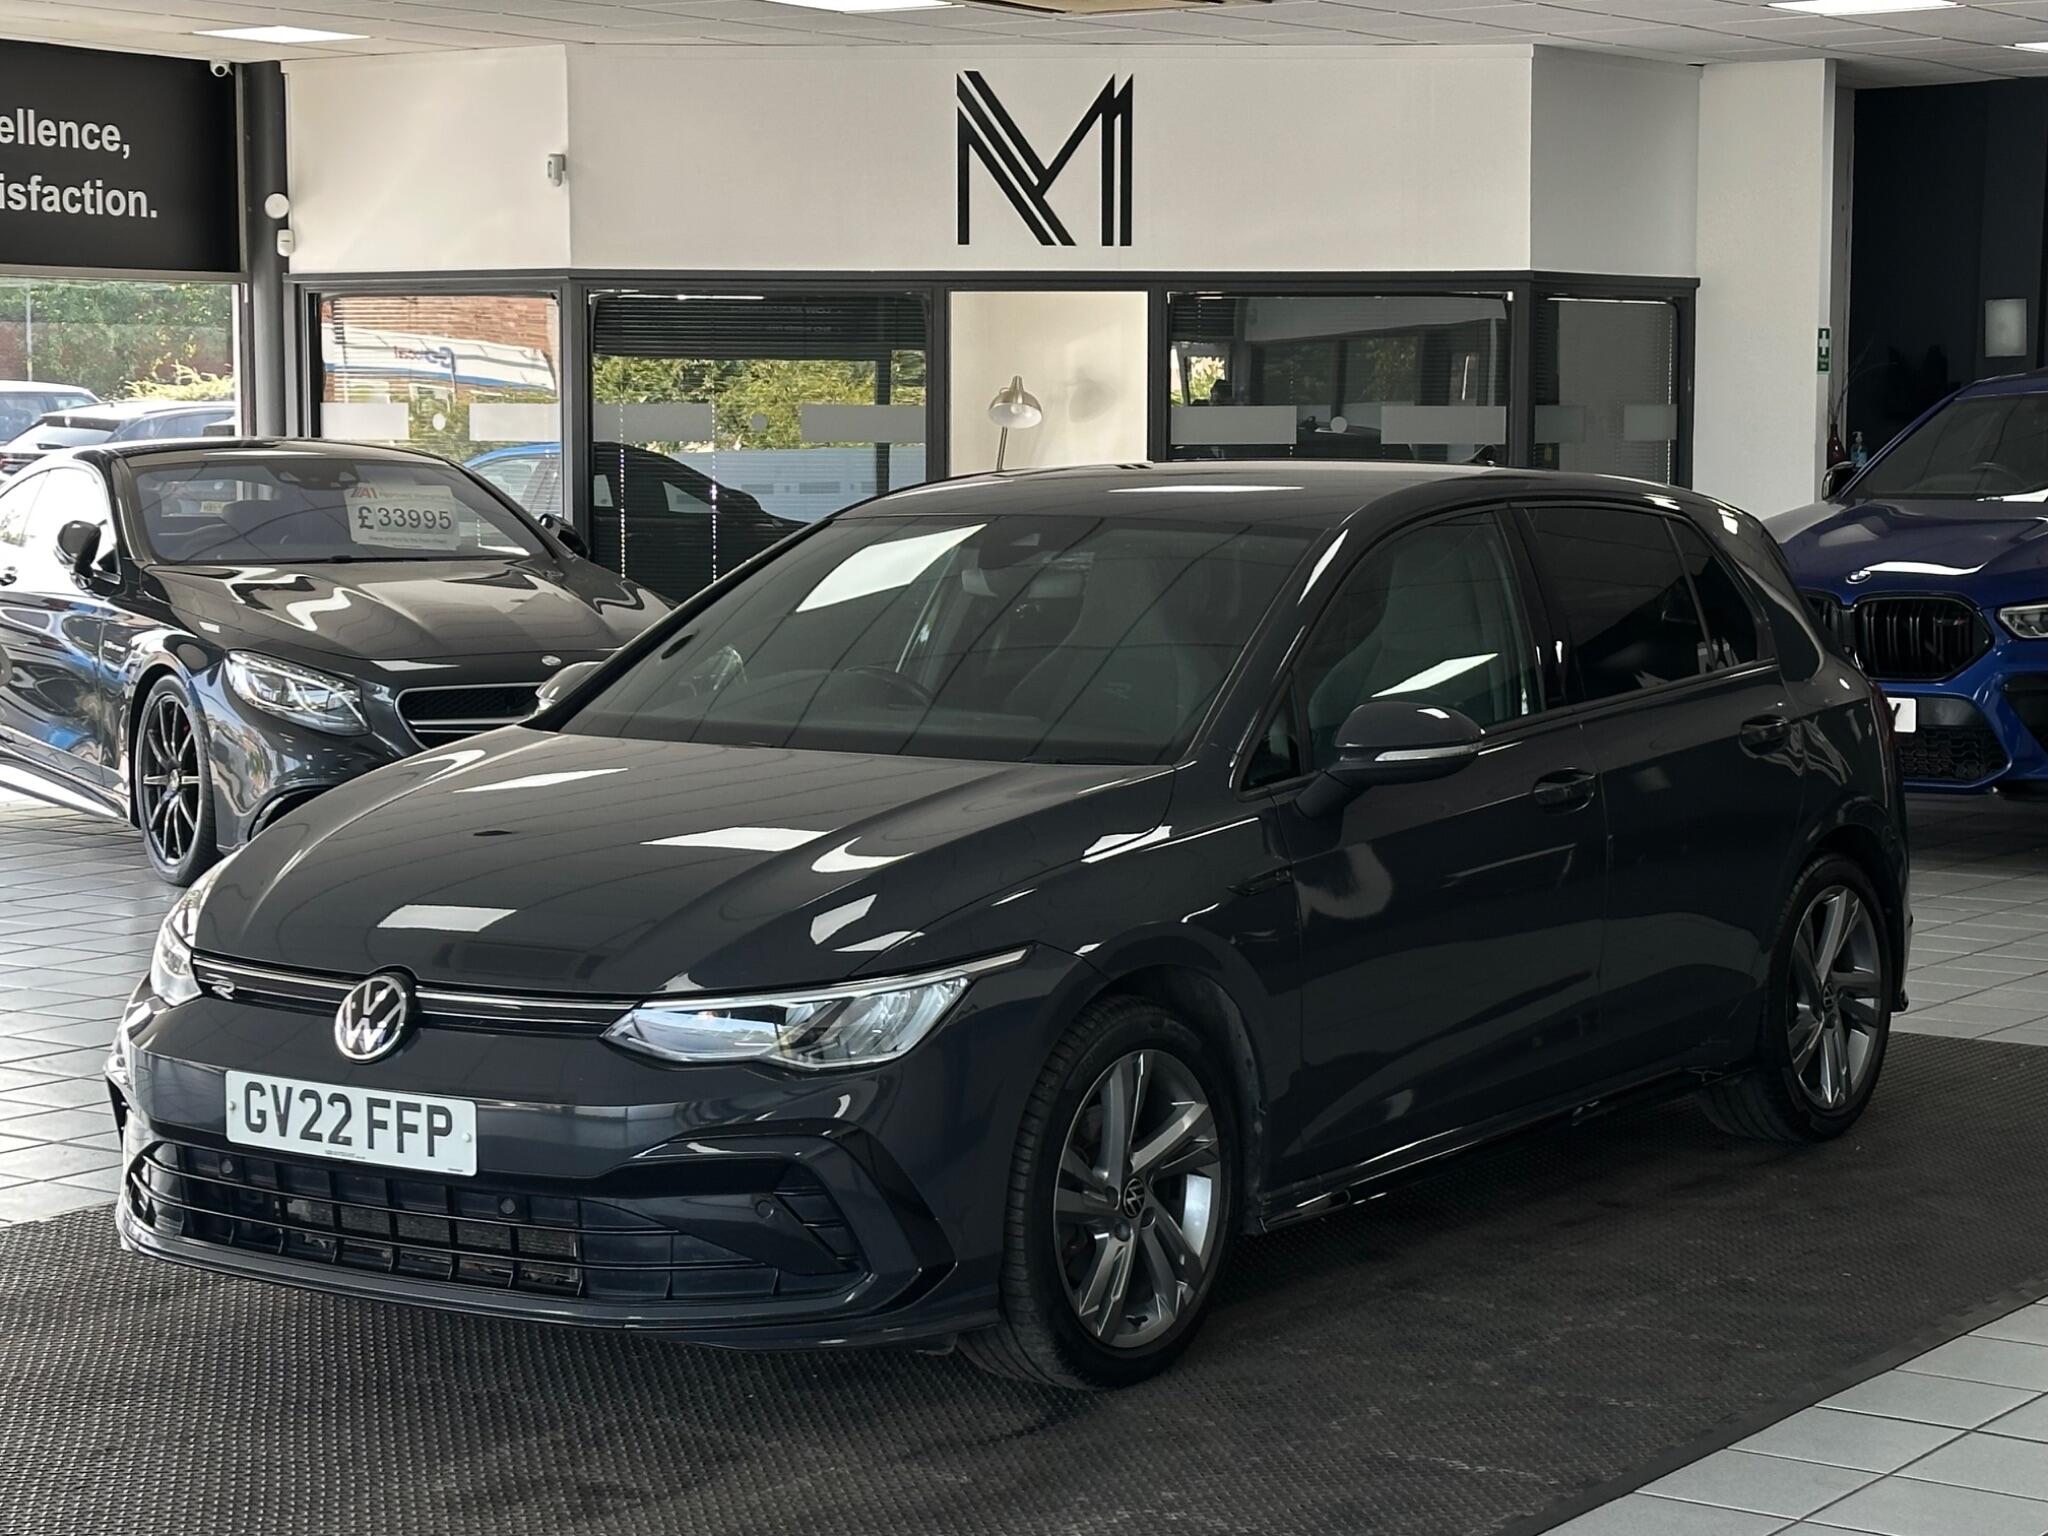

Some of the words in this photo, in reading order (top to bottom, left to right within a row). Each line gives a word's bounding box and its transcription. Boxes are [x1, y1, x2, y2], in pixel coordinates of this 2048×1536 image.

[357, 505, 452, 530] £33995
[244, 1081, 353, 1147] GV22
[366, 1097, 453, 1158] FFP
